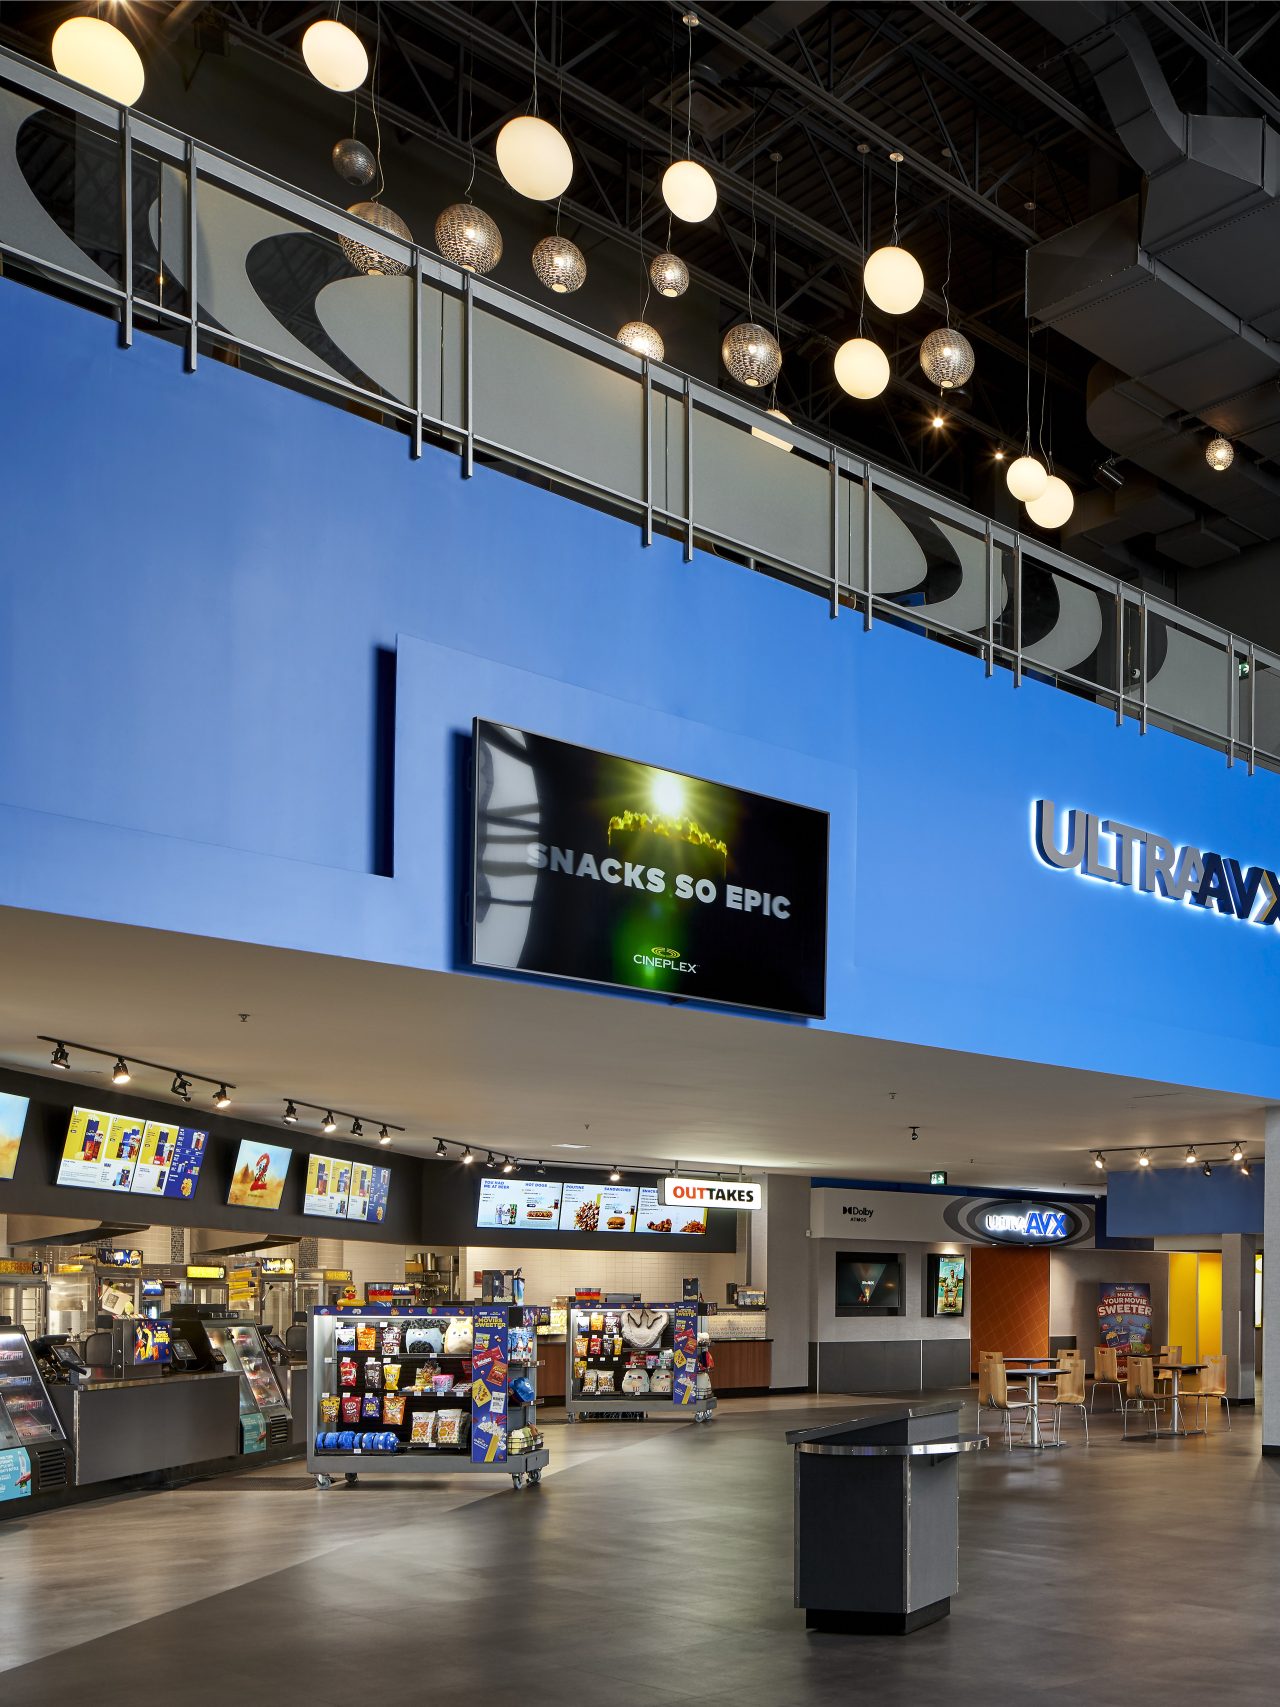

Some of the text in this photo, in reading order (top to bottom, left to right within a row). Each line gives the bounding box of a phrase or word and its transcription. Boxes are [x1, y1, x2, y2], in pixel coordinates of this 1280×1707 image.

[526, 841, 792, 920] SNACKS SO EPIC
[633, 954, 697, 974] CINEPLEX
[673, 1185, 754, 1202] OUTTAKES
[852, 1206, 874, 1217] Dolby
[1103, 1297, 1148, 1305] YOUR MOVIE
[1098, 1304, 1152, 1316] SWEETER
